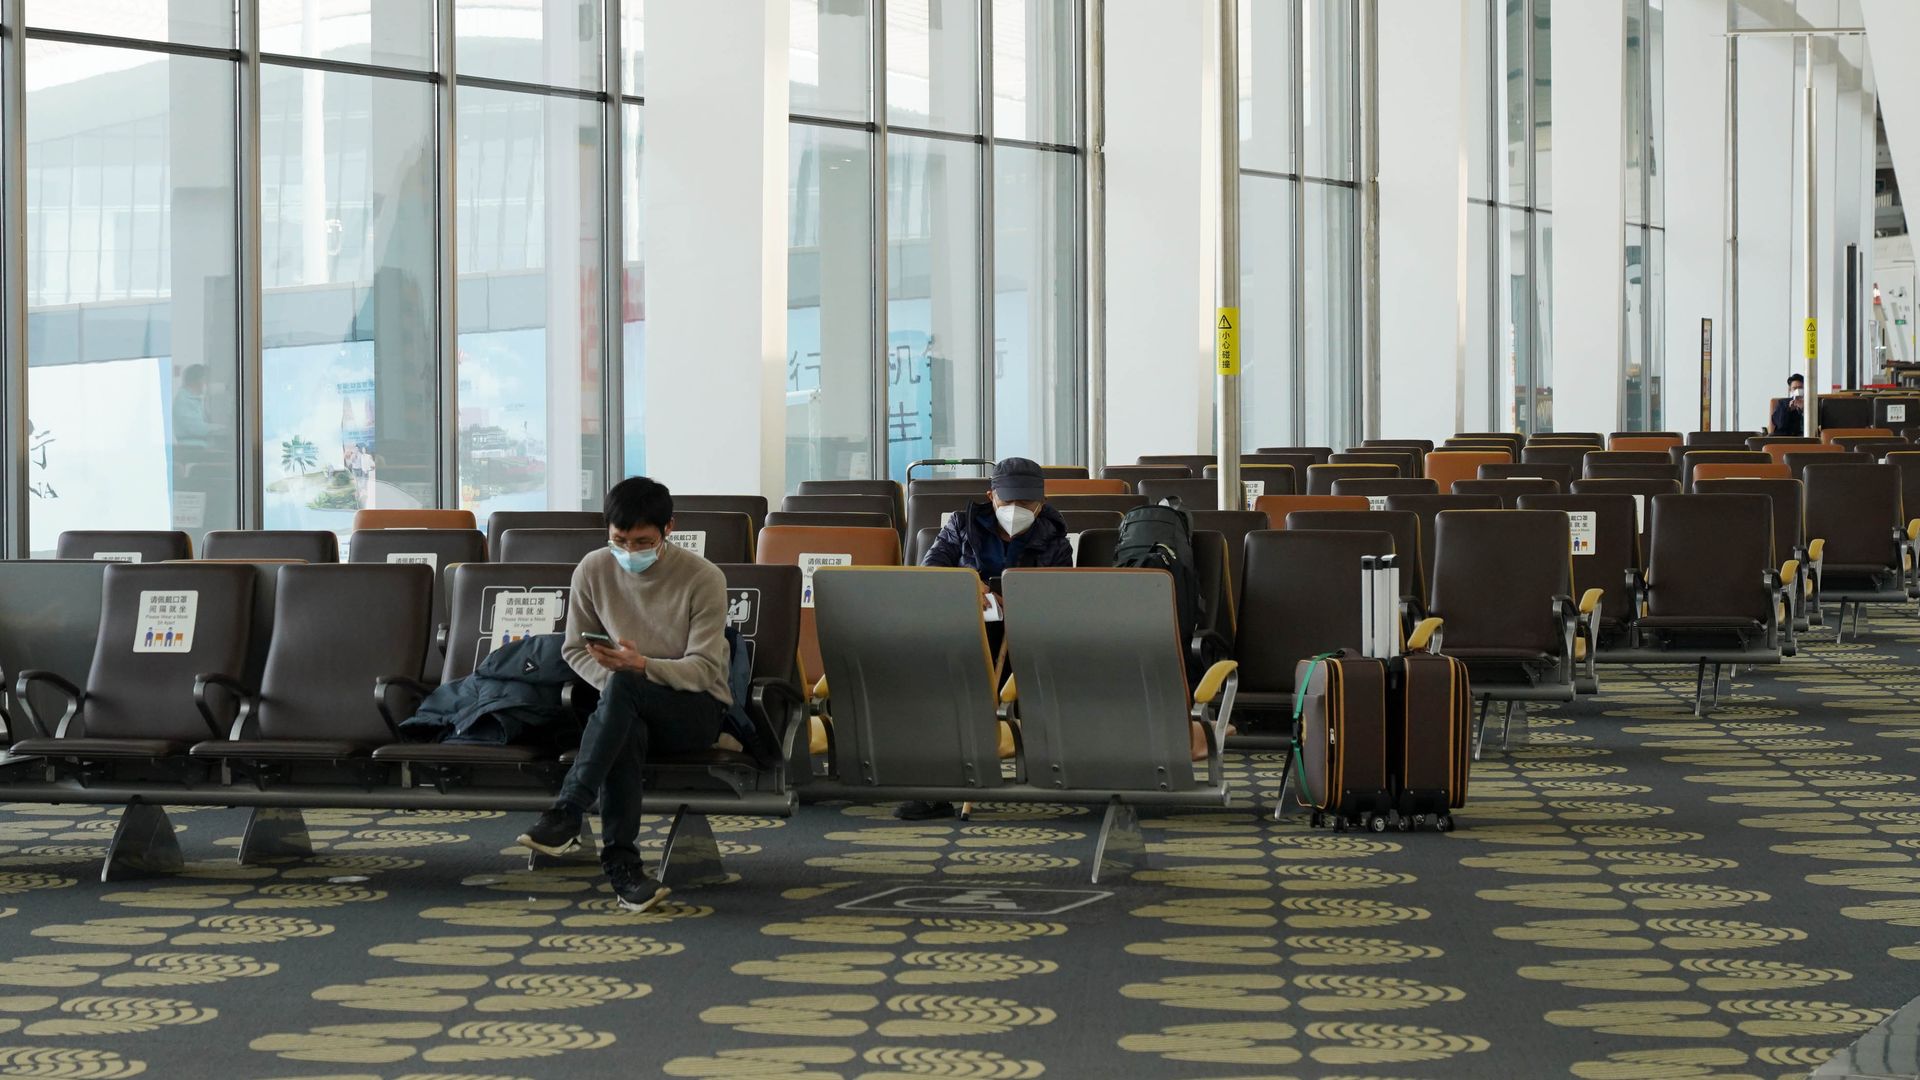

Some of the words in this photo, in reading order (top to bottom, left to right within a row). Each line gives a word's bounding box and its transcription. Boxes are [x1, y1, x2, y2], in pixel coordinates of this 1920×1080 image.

[1222, 332, 1230, 368] 小心碰撞
[150, 595, 188, 604] 请佩戴口罩
[506, 597, 545, 606] 请佩戴口罩
